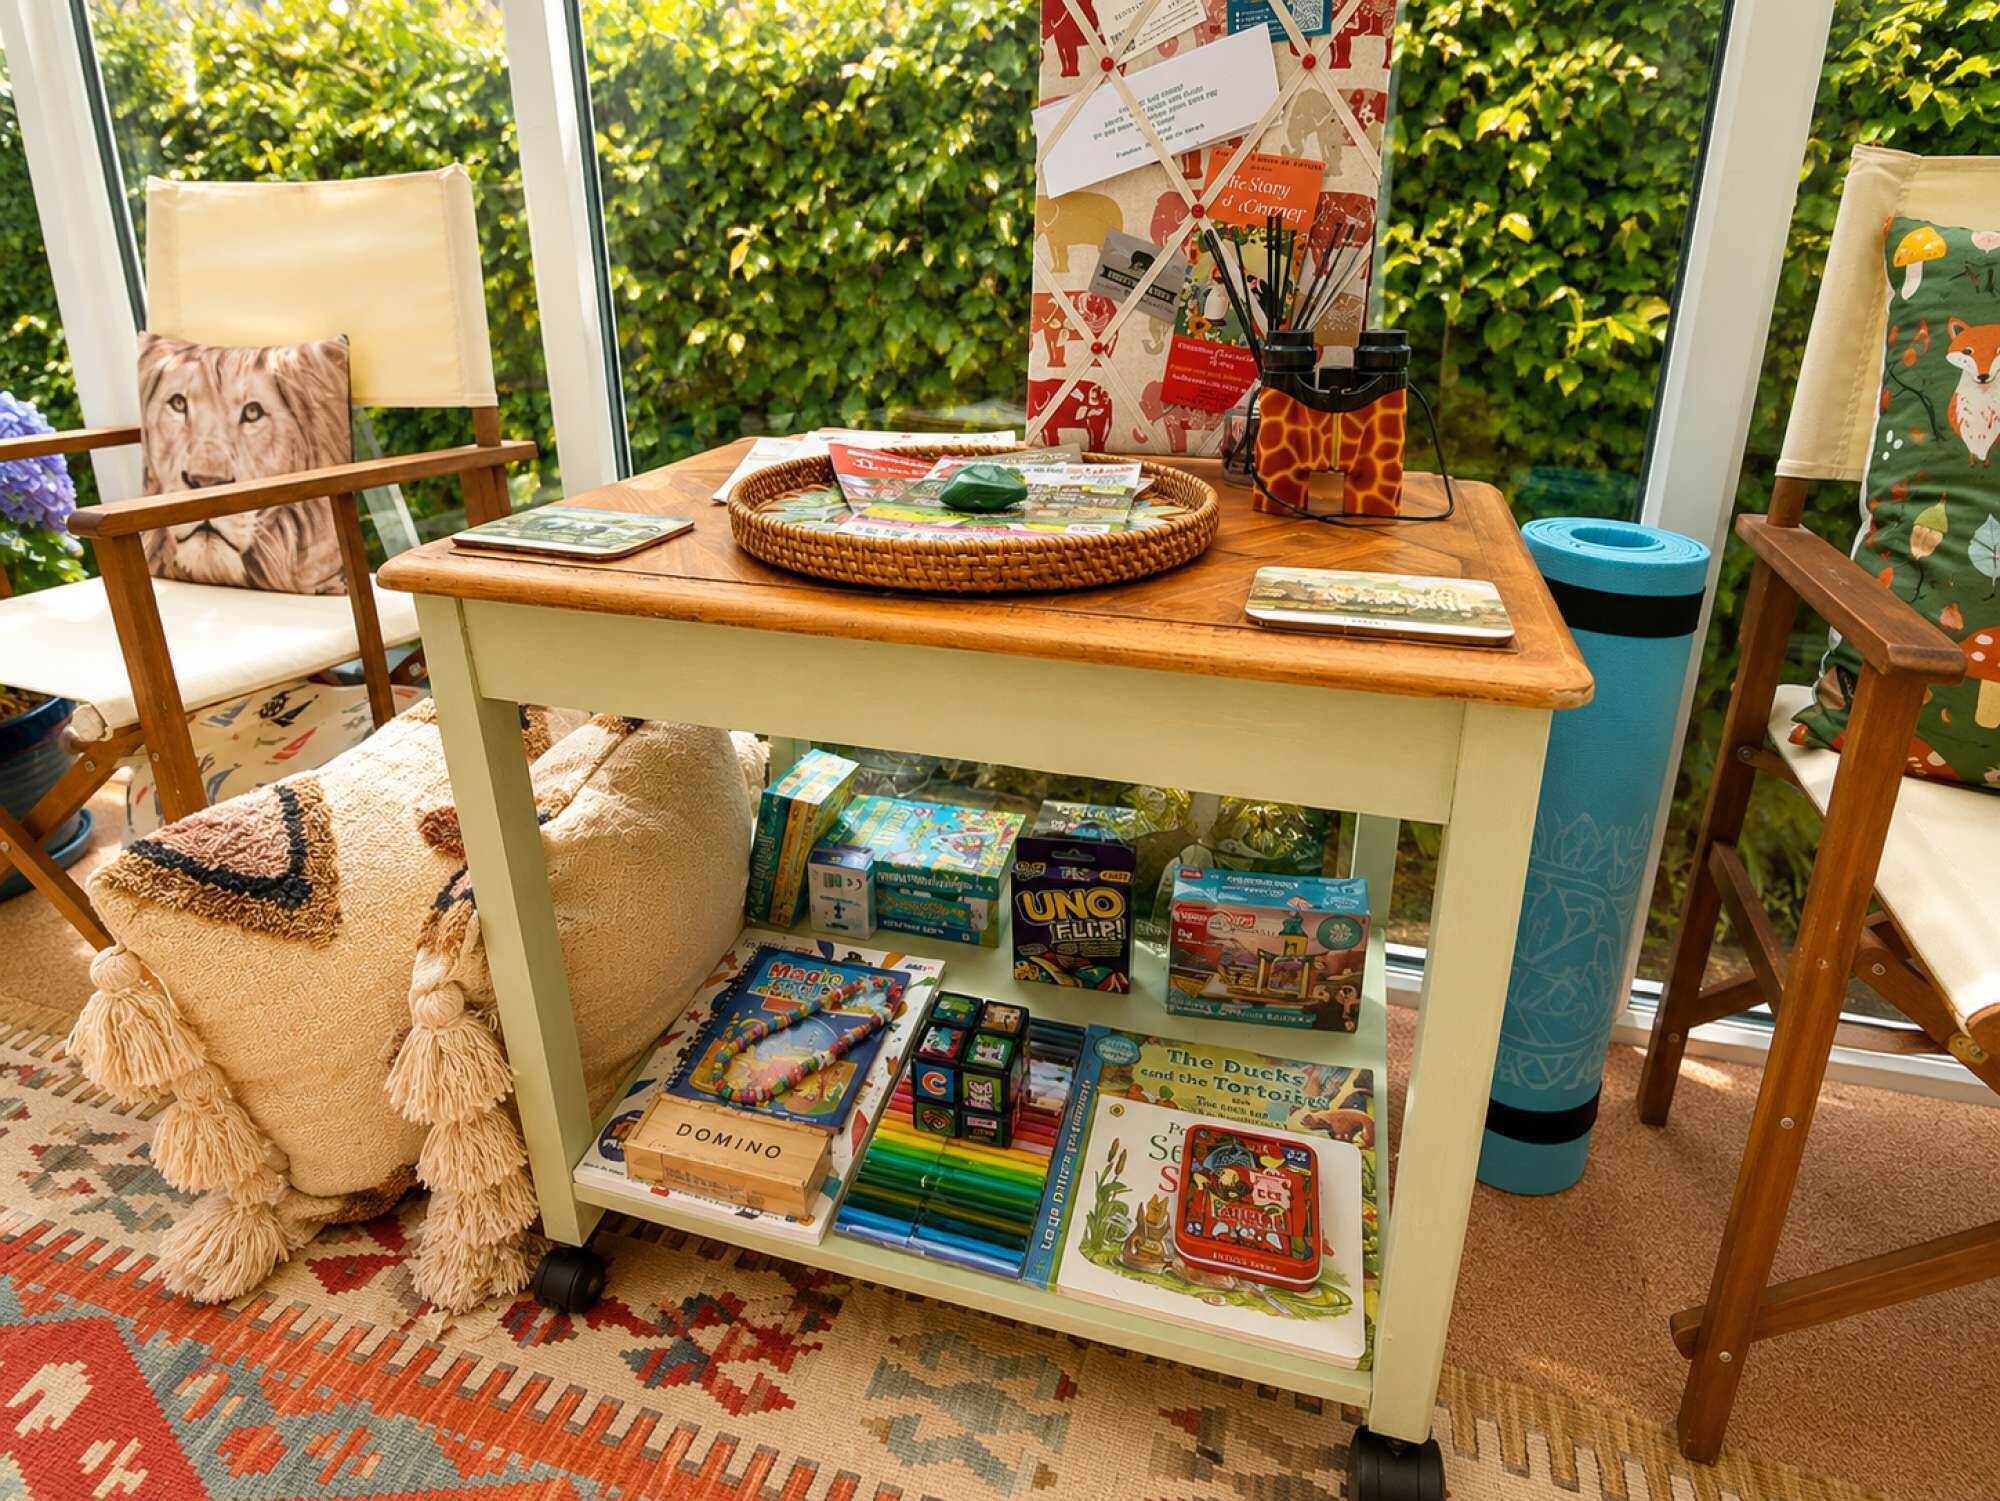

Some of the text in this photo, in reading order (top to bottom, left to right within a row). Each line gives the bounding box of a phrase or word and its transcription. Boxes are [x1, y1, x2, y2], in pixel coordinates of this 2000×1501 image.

[1248, 176, 1291, 200] Story
[1018, 887, 1124, 923] UNO
[1055, 919, 1122, 940] FLIP!
[1140, 1067, 1174, 1081] and
[1179, 1073, 1209, 1088] the
[1167, 1048, 1305, 1087] The Ducks
[676, 1123, 781, 1159] DOMINO
[1149, 1135, 1185, 1163] Se
